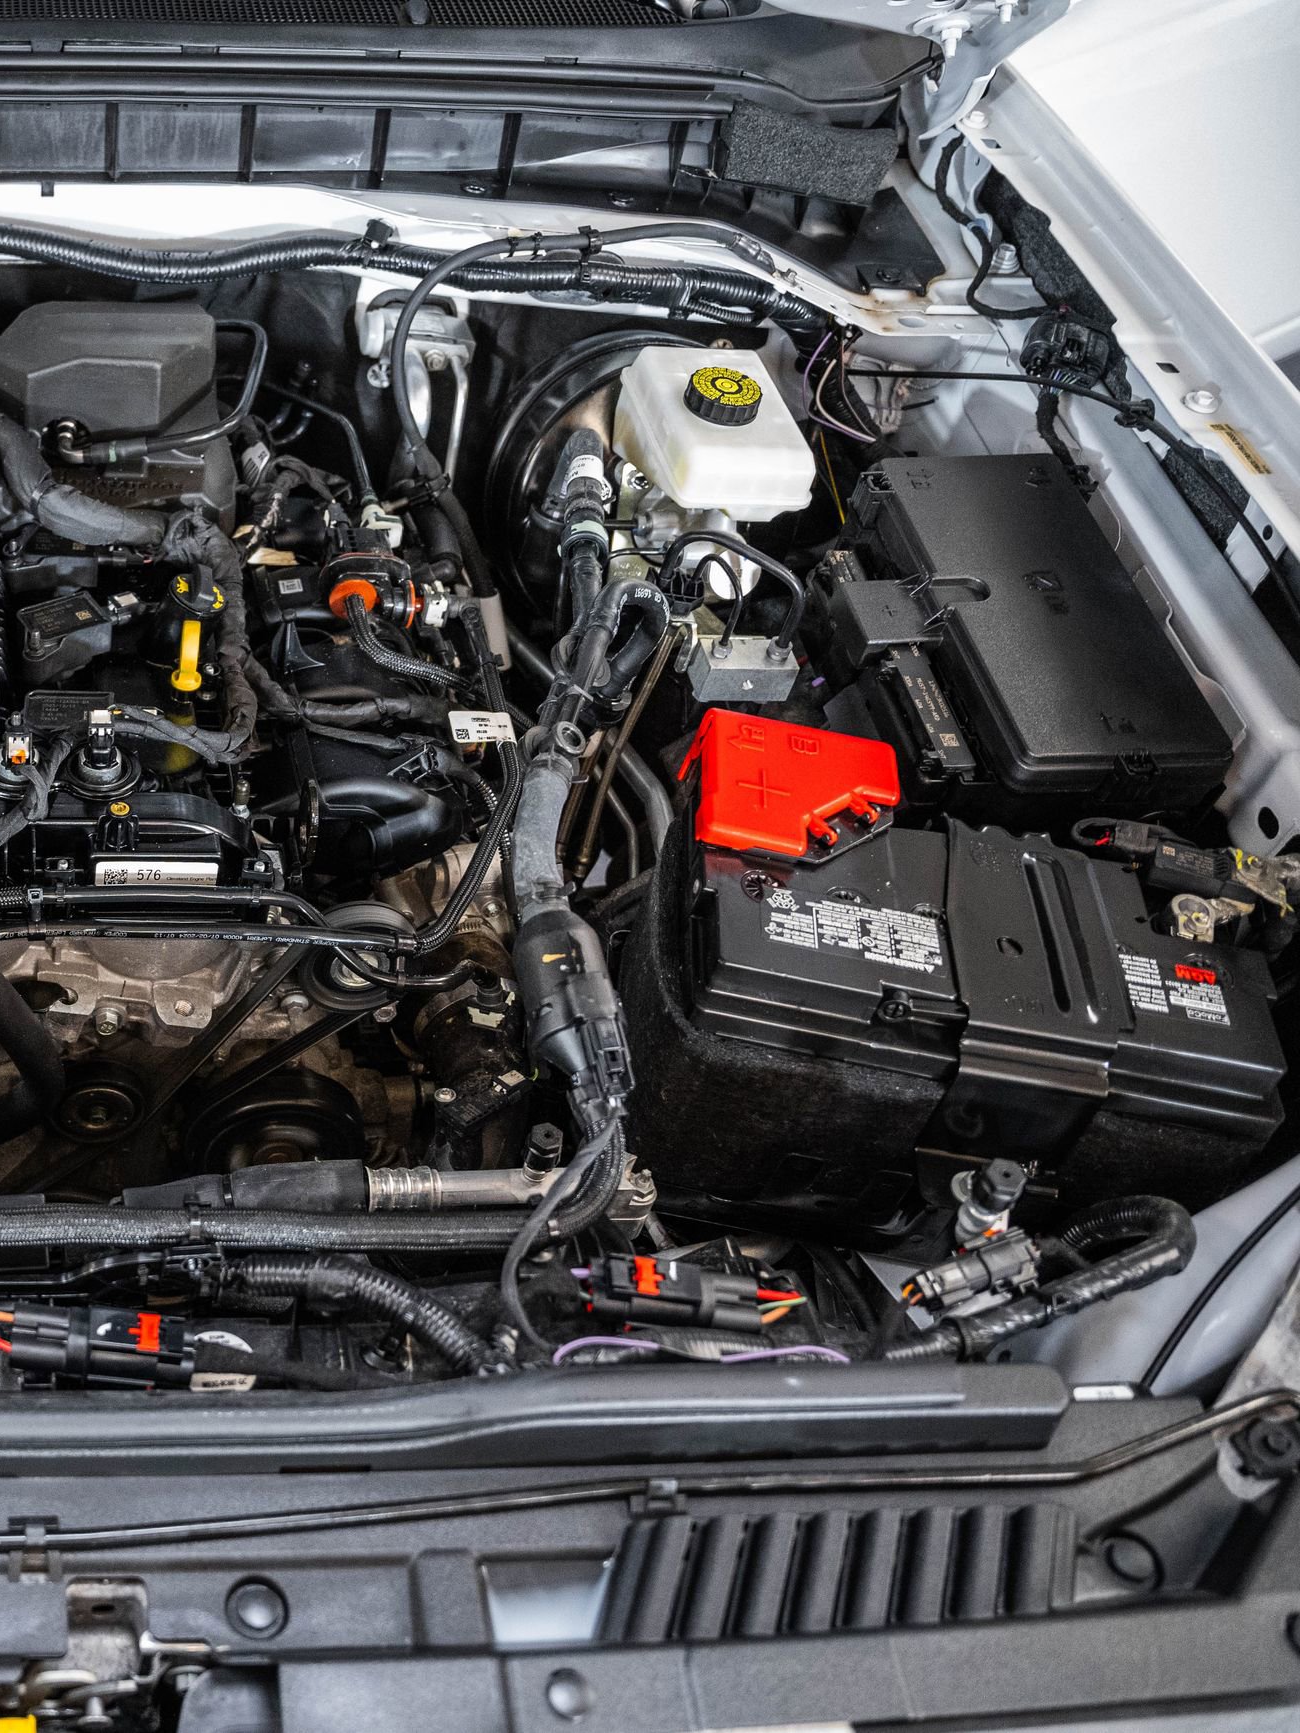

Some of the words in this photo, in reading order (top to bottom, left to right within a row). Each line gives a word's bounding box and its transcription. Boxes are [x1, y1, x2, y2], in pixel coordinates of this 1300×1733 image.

[137, 869, 162, 881] 576
[275, 937, 310, 946] STANDARD
[312, 939, 340, 947] COOPER
[1175, 967, 1216, 985] AGM
[1188, 1010, 1226, 1023] FoMoCo
